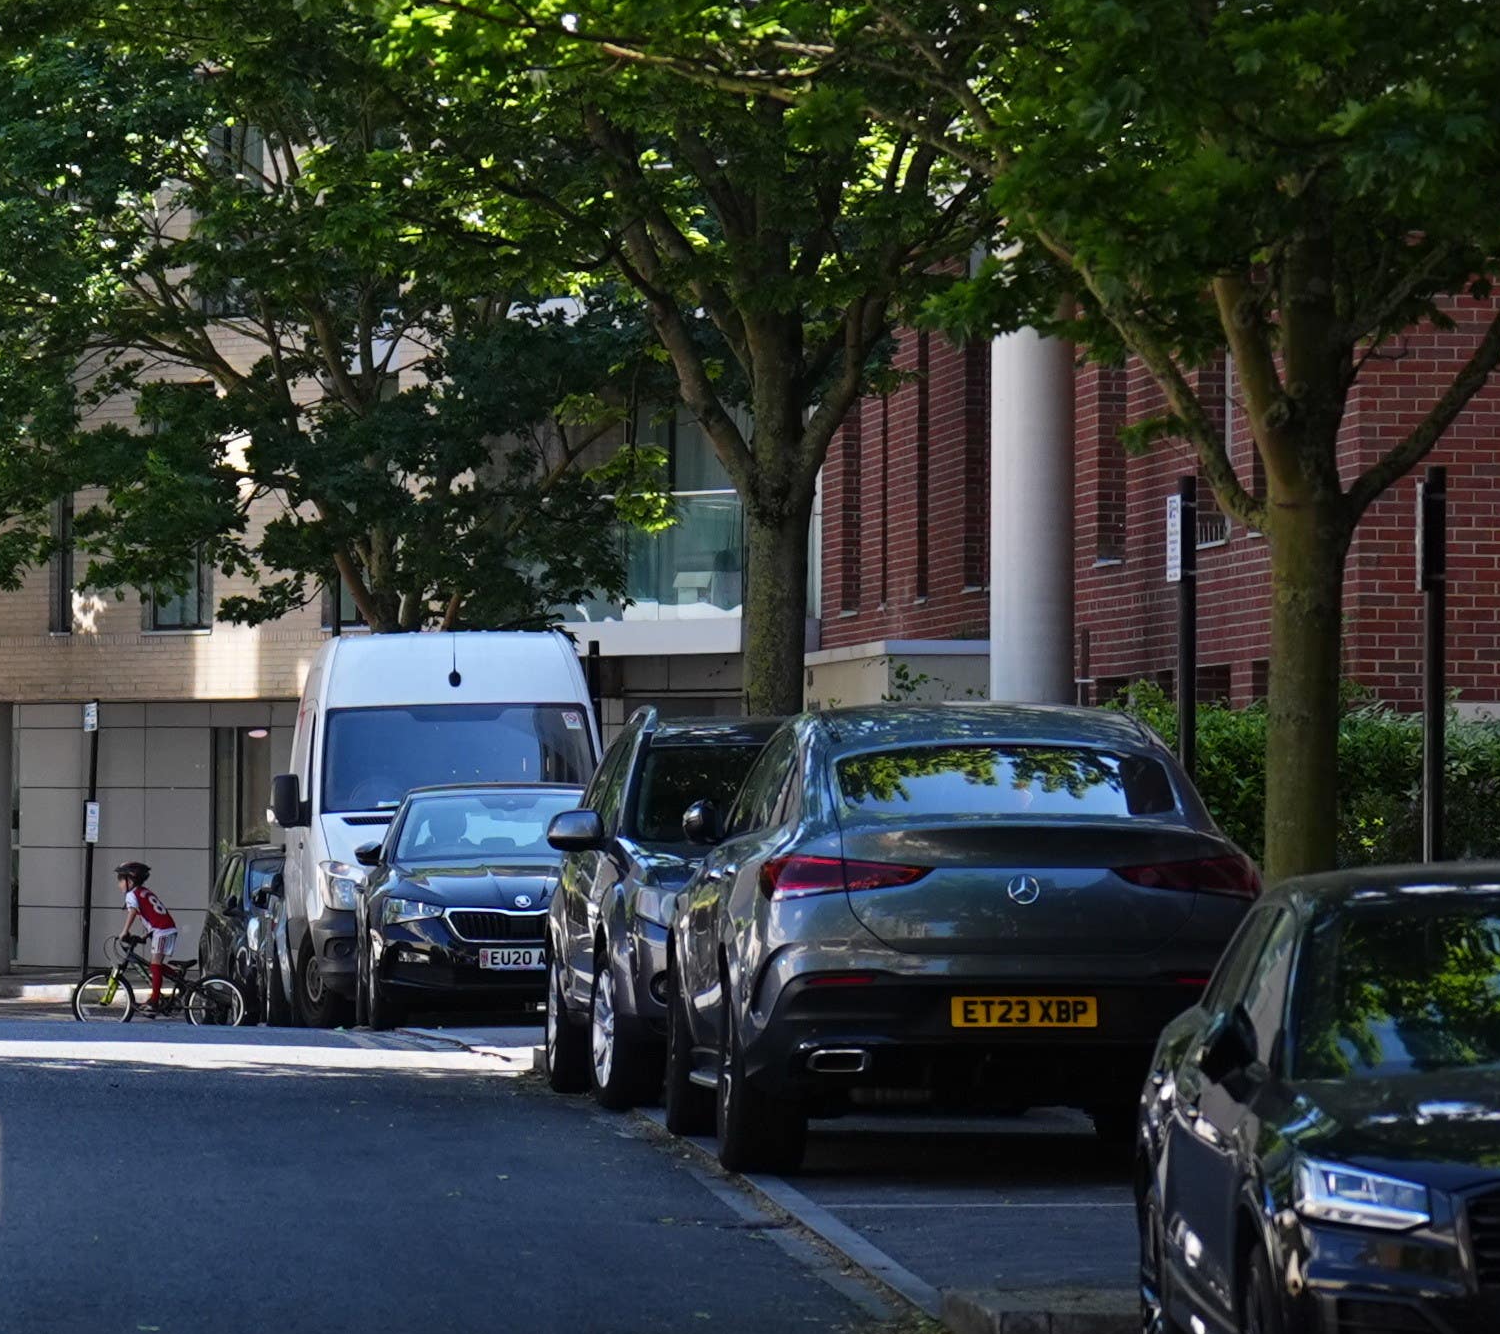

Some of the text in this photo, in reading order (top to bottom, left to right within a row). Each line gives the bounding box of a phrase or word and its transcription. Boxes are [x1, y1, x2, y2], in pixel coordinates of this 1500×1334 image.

[148, 895, 167, 915] 8
[491, 951, 532, 966] EU20
[963, 1000, 1088, 1023] ET23 XBP
